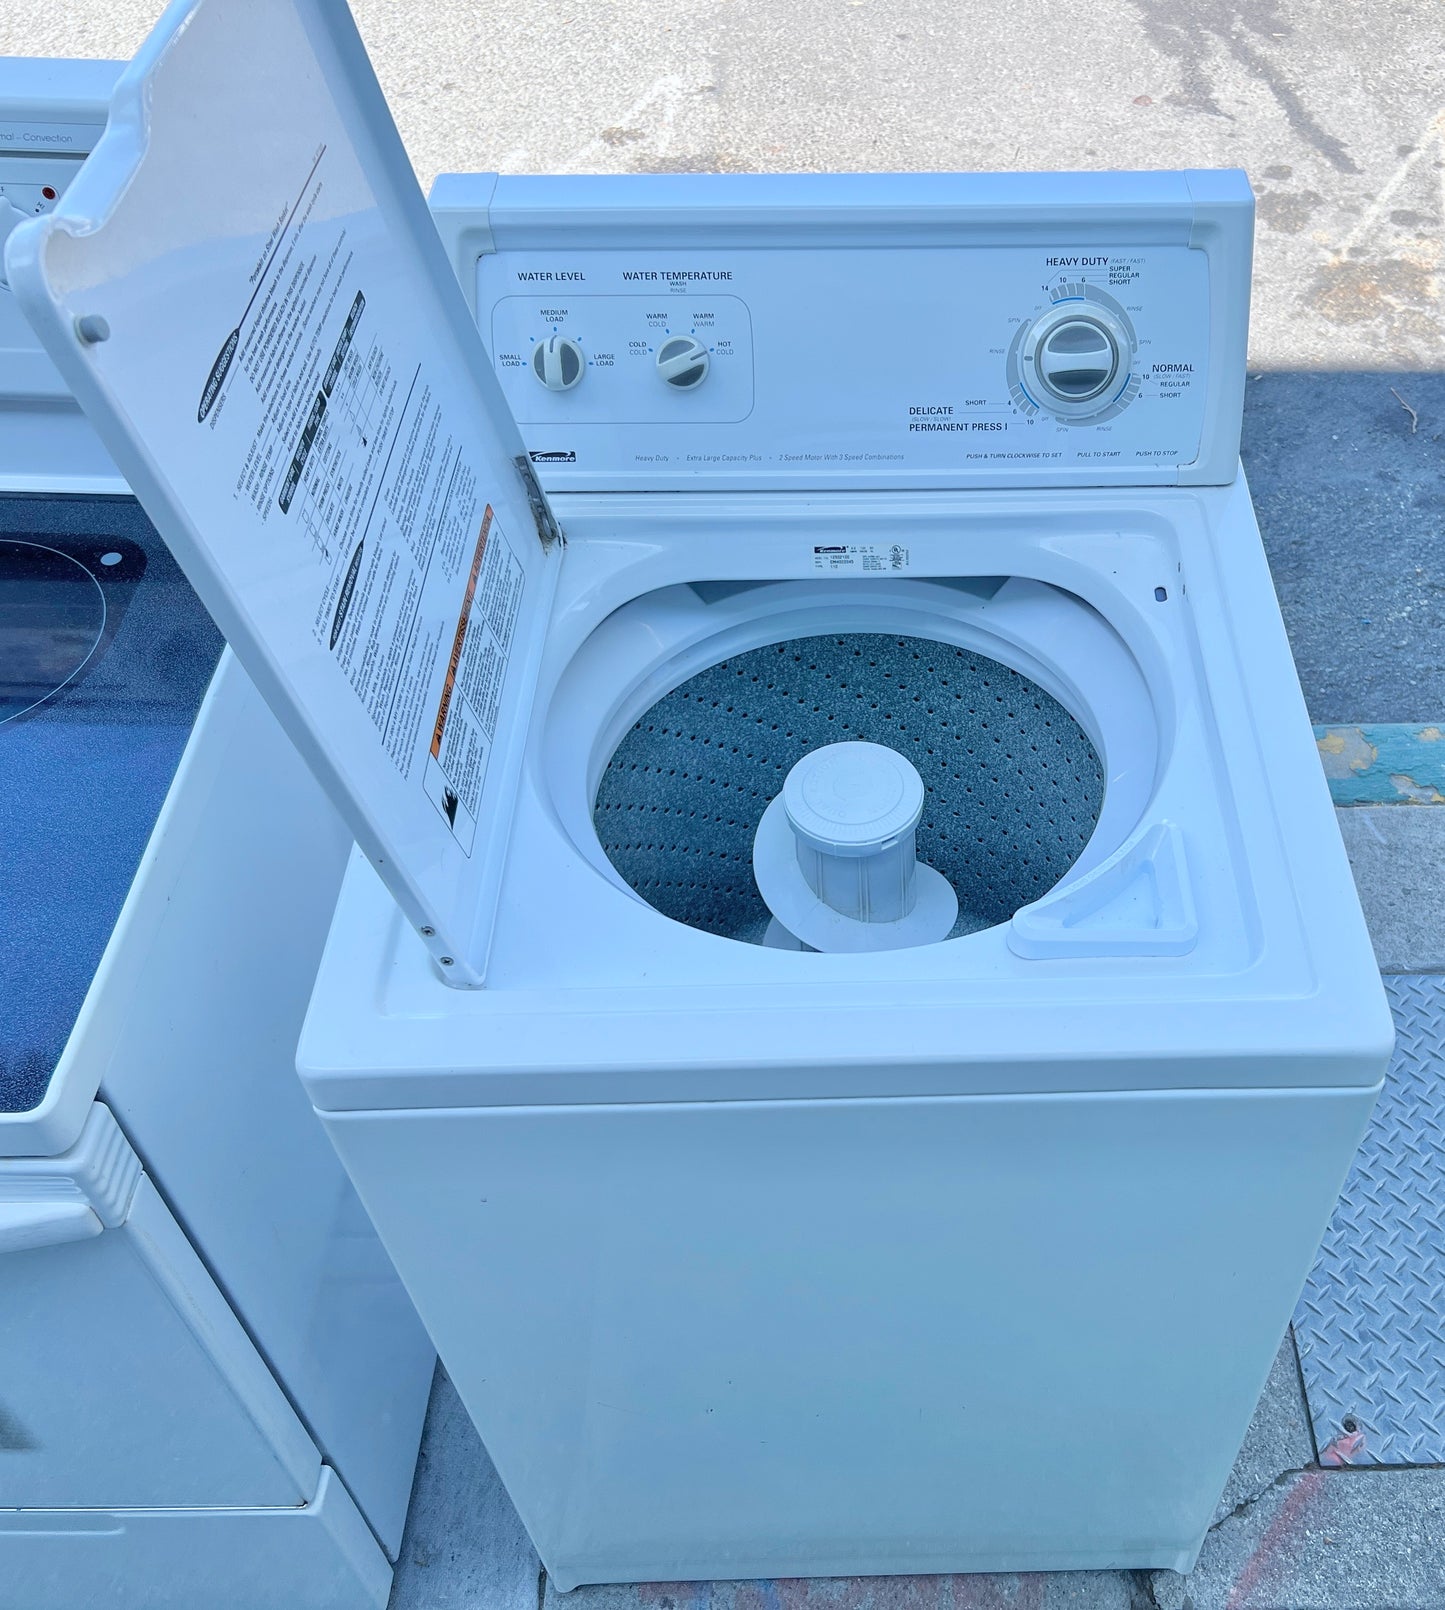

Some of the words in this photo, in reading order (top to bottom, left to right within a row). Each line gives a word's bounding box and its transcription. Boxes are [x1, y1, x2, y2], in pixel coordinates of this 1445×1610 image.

[23, 133, 72, 143] Convection
[1046, 258, 1079, 266] HEAVY
[1082, 258, 1108, 266] DUTY
[518, 272, 552, 281] WATER
[555, 272, 586, 281] LEVEL
[623, 272, 657, 280] WATER
[660, 271, 732, 280] TEMPERATURE
[199, 377, 218, 417] OPERATING
[215, 333, 238, 381] SUGGESTIONS
[1152, 364, 1194, 372] NORMAL
[210, 393, 226, 429] DISPENSERS
[237, 469, 246, 491] SELECT
[247, 440, 257, 463] ADJUST
[246, 469, 255, 491] WATER
[252, 481, 260, 501] WASH
[264, 468, 274, 493] OPTIONS
[262, 497, 272, 521] SPEEDS
[346, 565, 356, 597] REMOVAL
[316, 604, 324, 627] SELECT
[437, 681, 452, 735] WARNING
